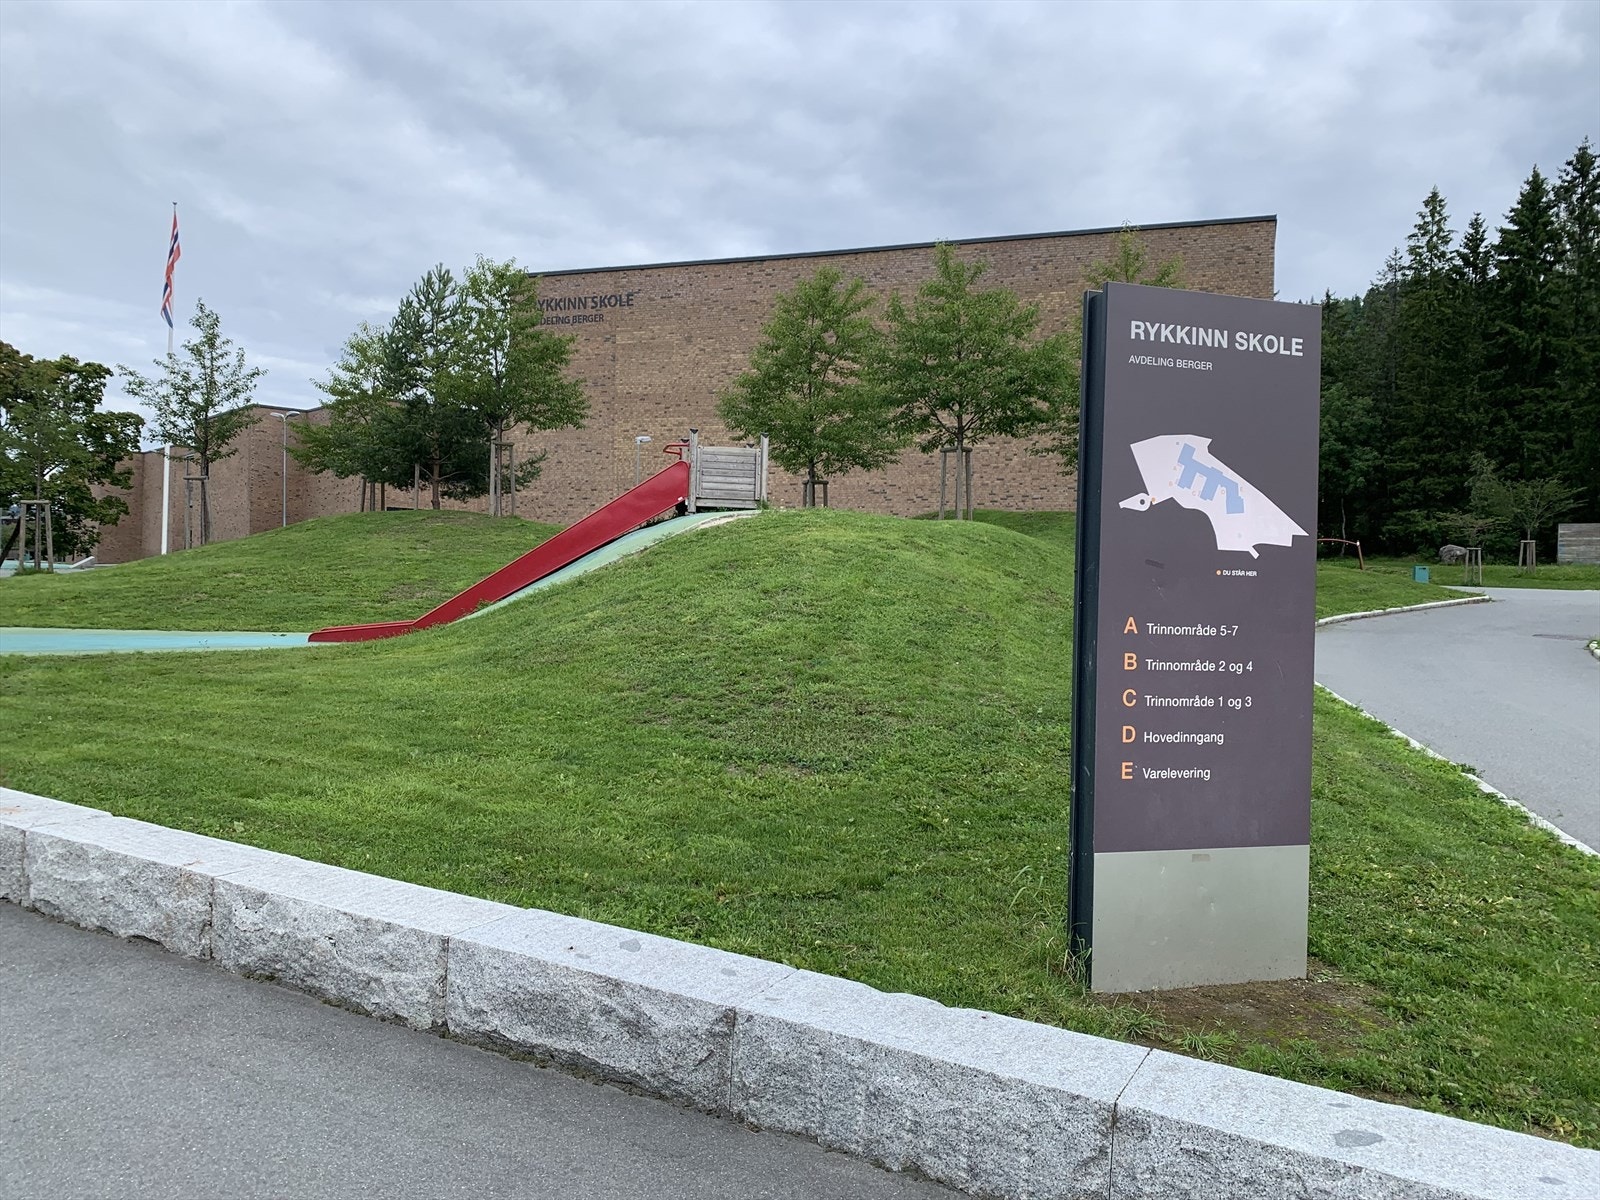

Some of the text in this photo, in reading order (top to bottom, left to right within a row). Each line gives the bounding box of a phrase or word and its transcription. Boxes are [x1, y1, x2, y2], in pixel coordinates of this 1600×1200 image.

[537, 294, 634, 311] YKKINN SKOLE
[540, 313, 605, 326] DELING BERGER
[1130, 320, 1304, 357] RYKKINN SKOLE
[1128, 355, 1213, 371] AVDELING BERGER
[1123, 616, 1239, 636] A Trinnområde 5-7
[1123, 652, 1253, 674] B Trinnområde 2 og 4
[1122, 688, 1252, 710] C Trinnområde 1 og 3
[1122, 725, 1224, 745] D Hovedinngang
[1121, 762, 1211, 781] E Varelevering
